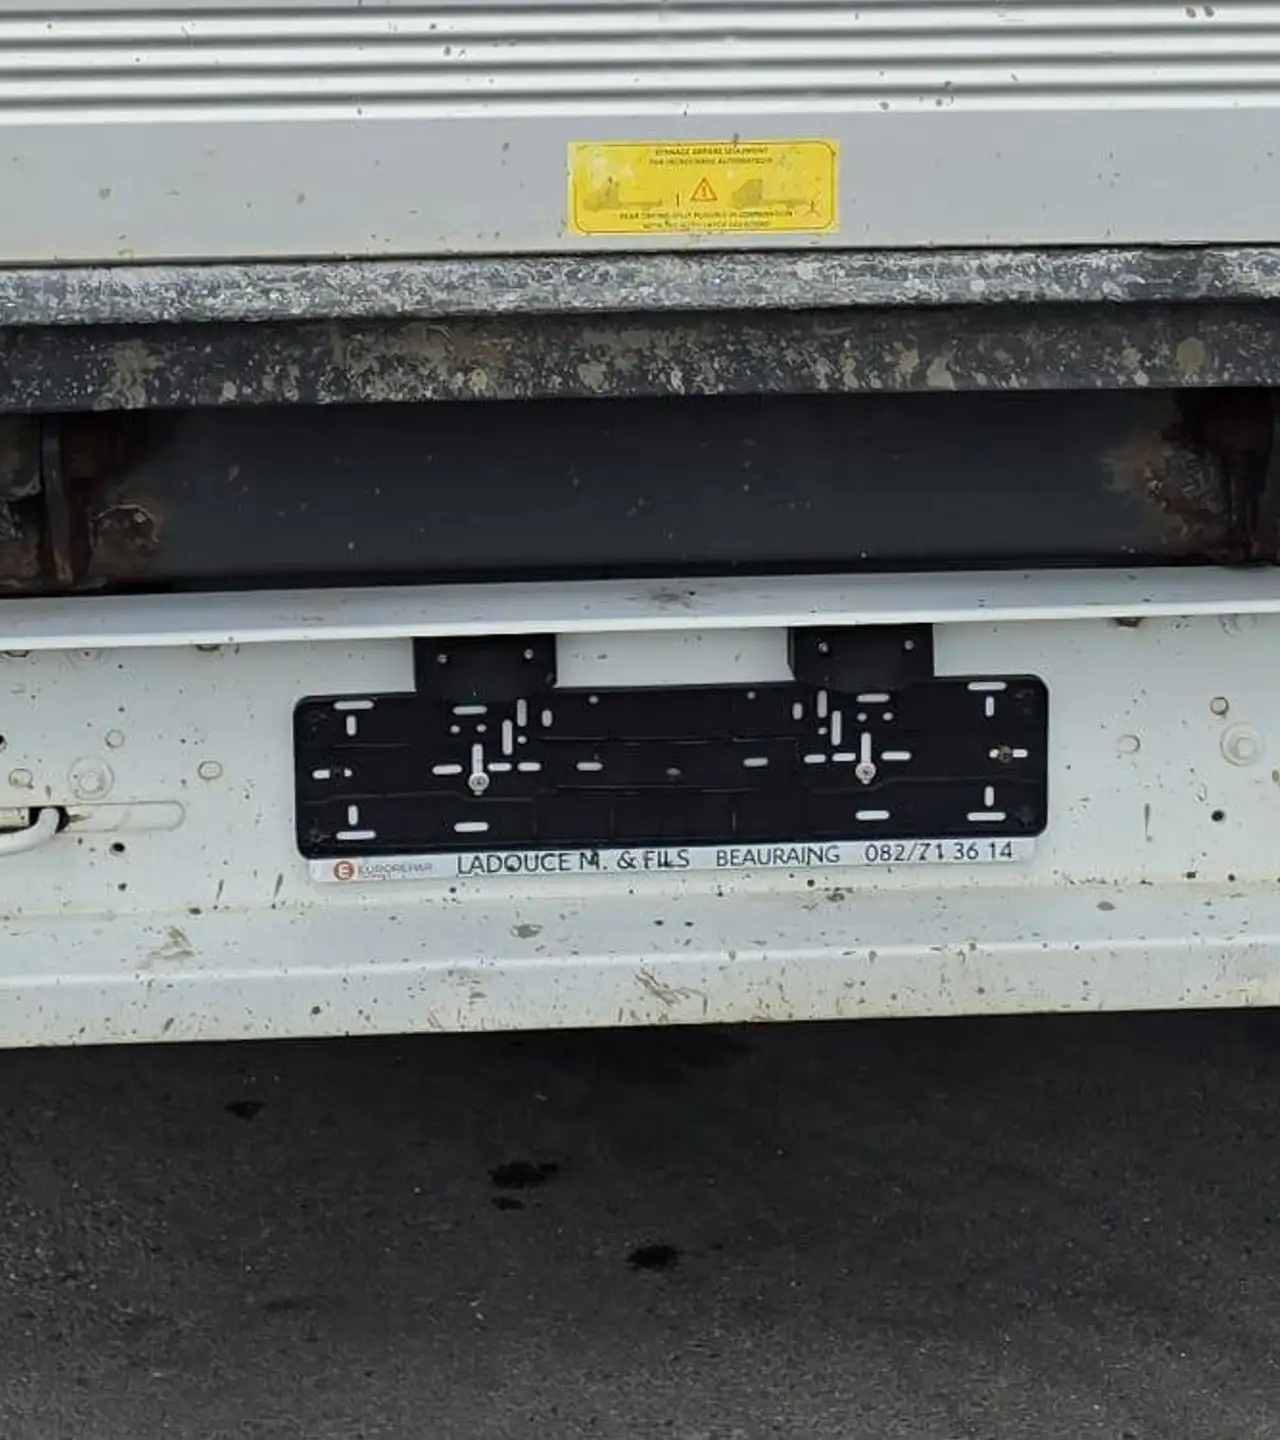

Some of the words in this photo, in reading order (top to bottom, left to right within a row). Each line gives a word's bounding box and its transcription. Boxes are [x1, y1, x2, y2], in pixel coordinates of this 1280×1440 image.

[457, 852, 570, 875] LADOUCE
[579, 850, 608, 871] M.
[617, 849, 637, 869] &
[643, 848, 690, 869] FILS
[716, 844, 841, 867] BEAURAING
[864, 841, 945, 862] 082/71
[952, 841, 979, 861] 36
[989, 840, 1013, 860] 14
